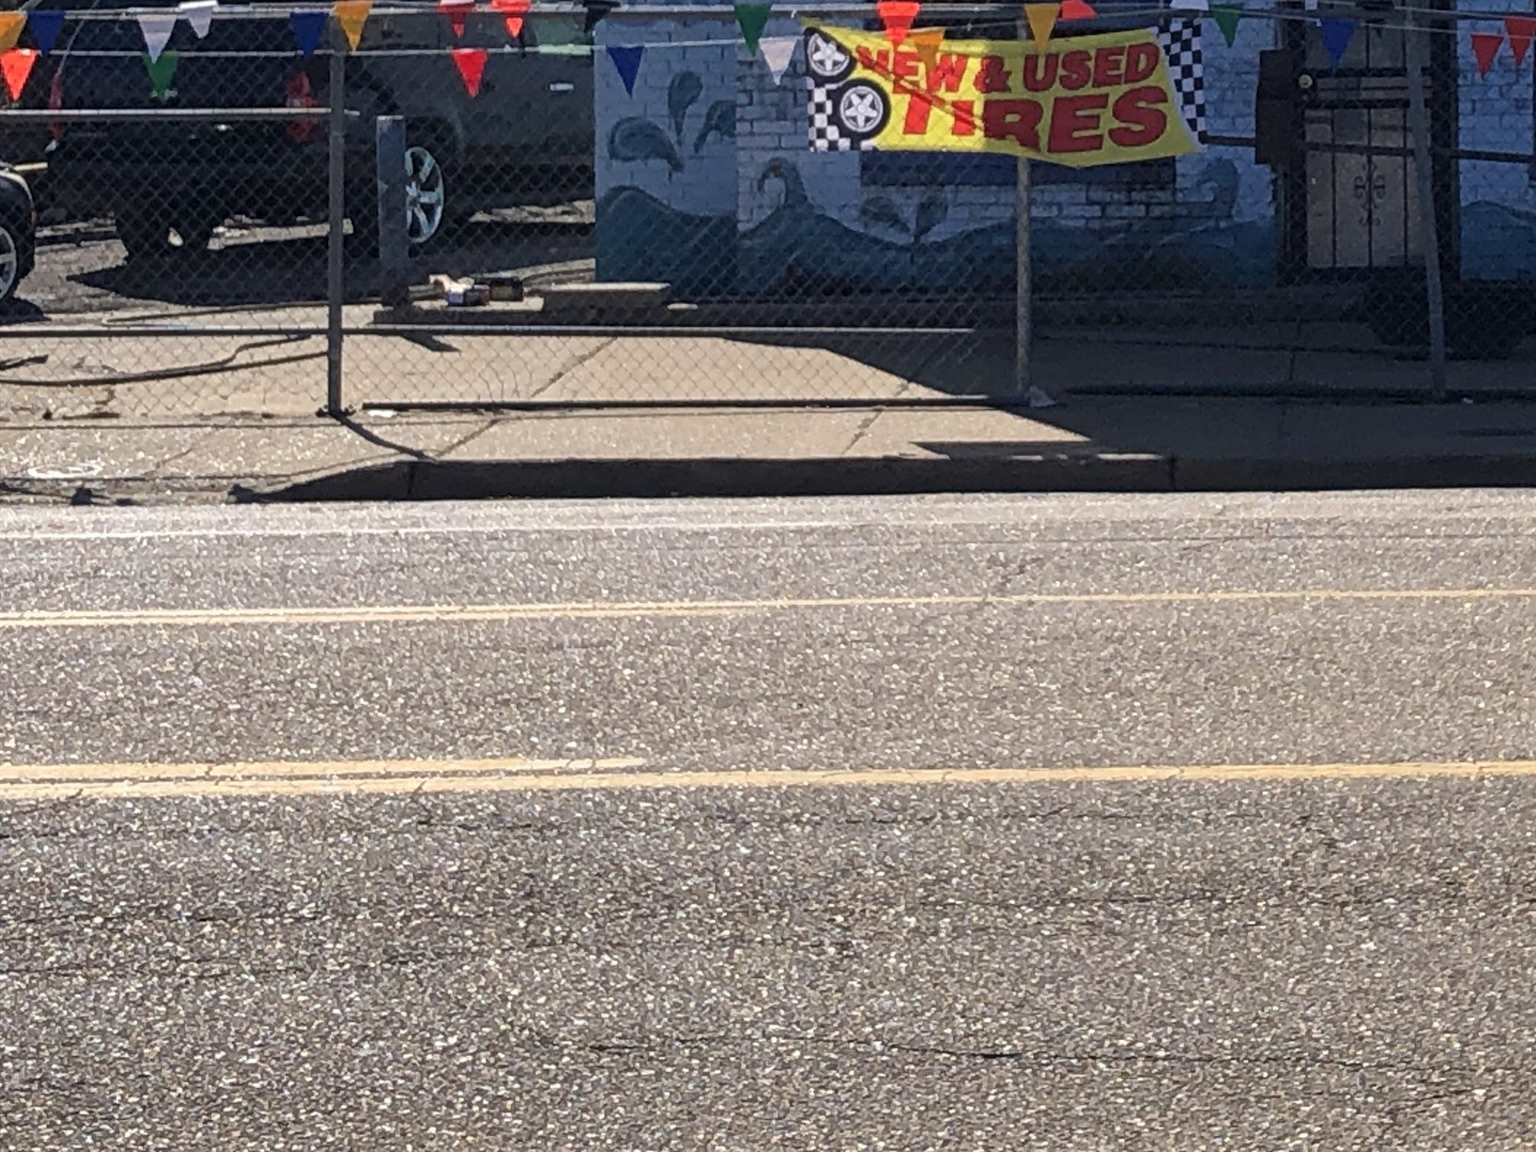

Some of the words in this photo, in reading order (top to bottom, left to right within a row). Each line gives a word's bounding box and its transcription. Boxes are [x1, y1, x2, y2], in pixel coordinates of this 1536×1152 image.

[973, 54, 1012, 94] &
[1022, 42, 1161, 93] USED
[901, 85, 1169, 154] TIRES
